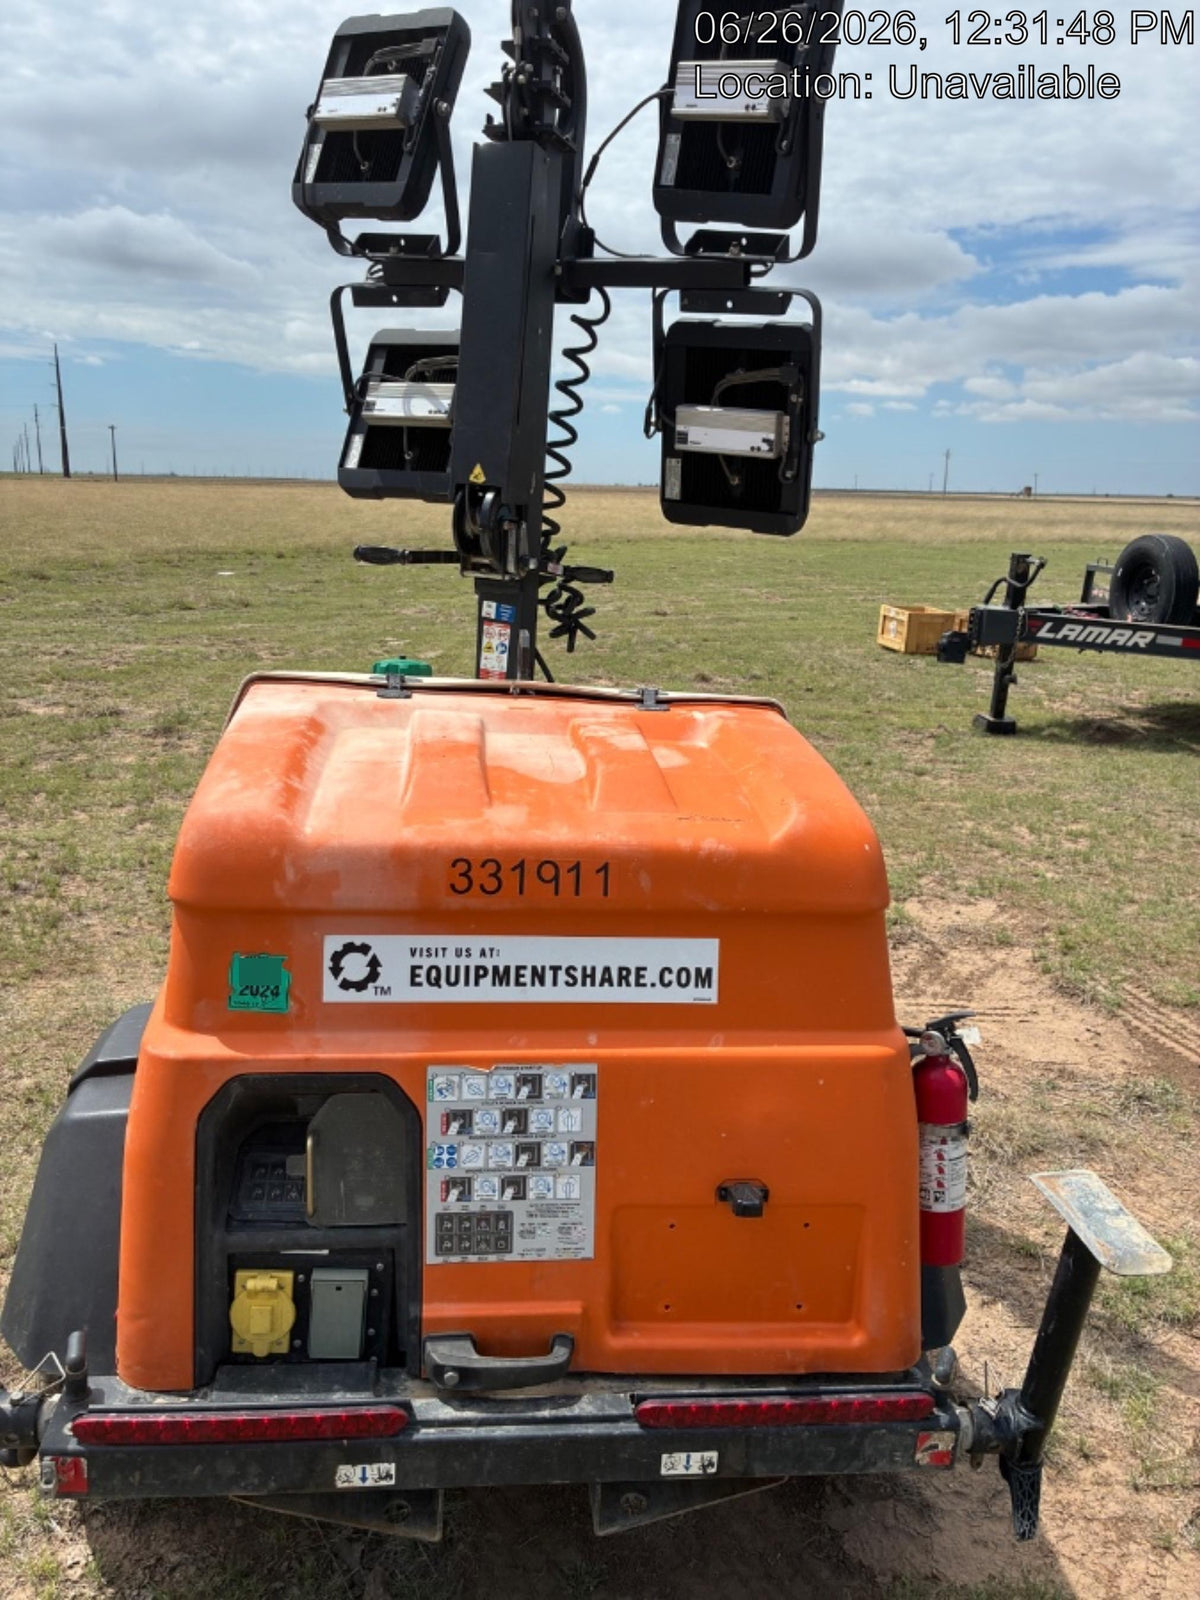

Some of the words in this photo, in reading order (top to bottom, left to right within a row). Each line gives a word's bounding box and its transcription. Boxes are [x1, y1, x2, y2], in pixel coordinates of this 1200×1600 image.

[1036, 621, 1157, 648] LAMAR
[449, 857, 610, 897] 331911
[409, 946, 449, 959] VISIT
[454, 947, 473, 959] US
[479, 947, 501, 959] AT:
[409, 964, 713, 990] EQUIPMENTSHARE.COM
[373, 985, 392, 996] TM
